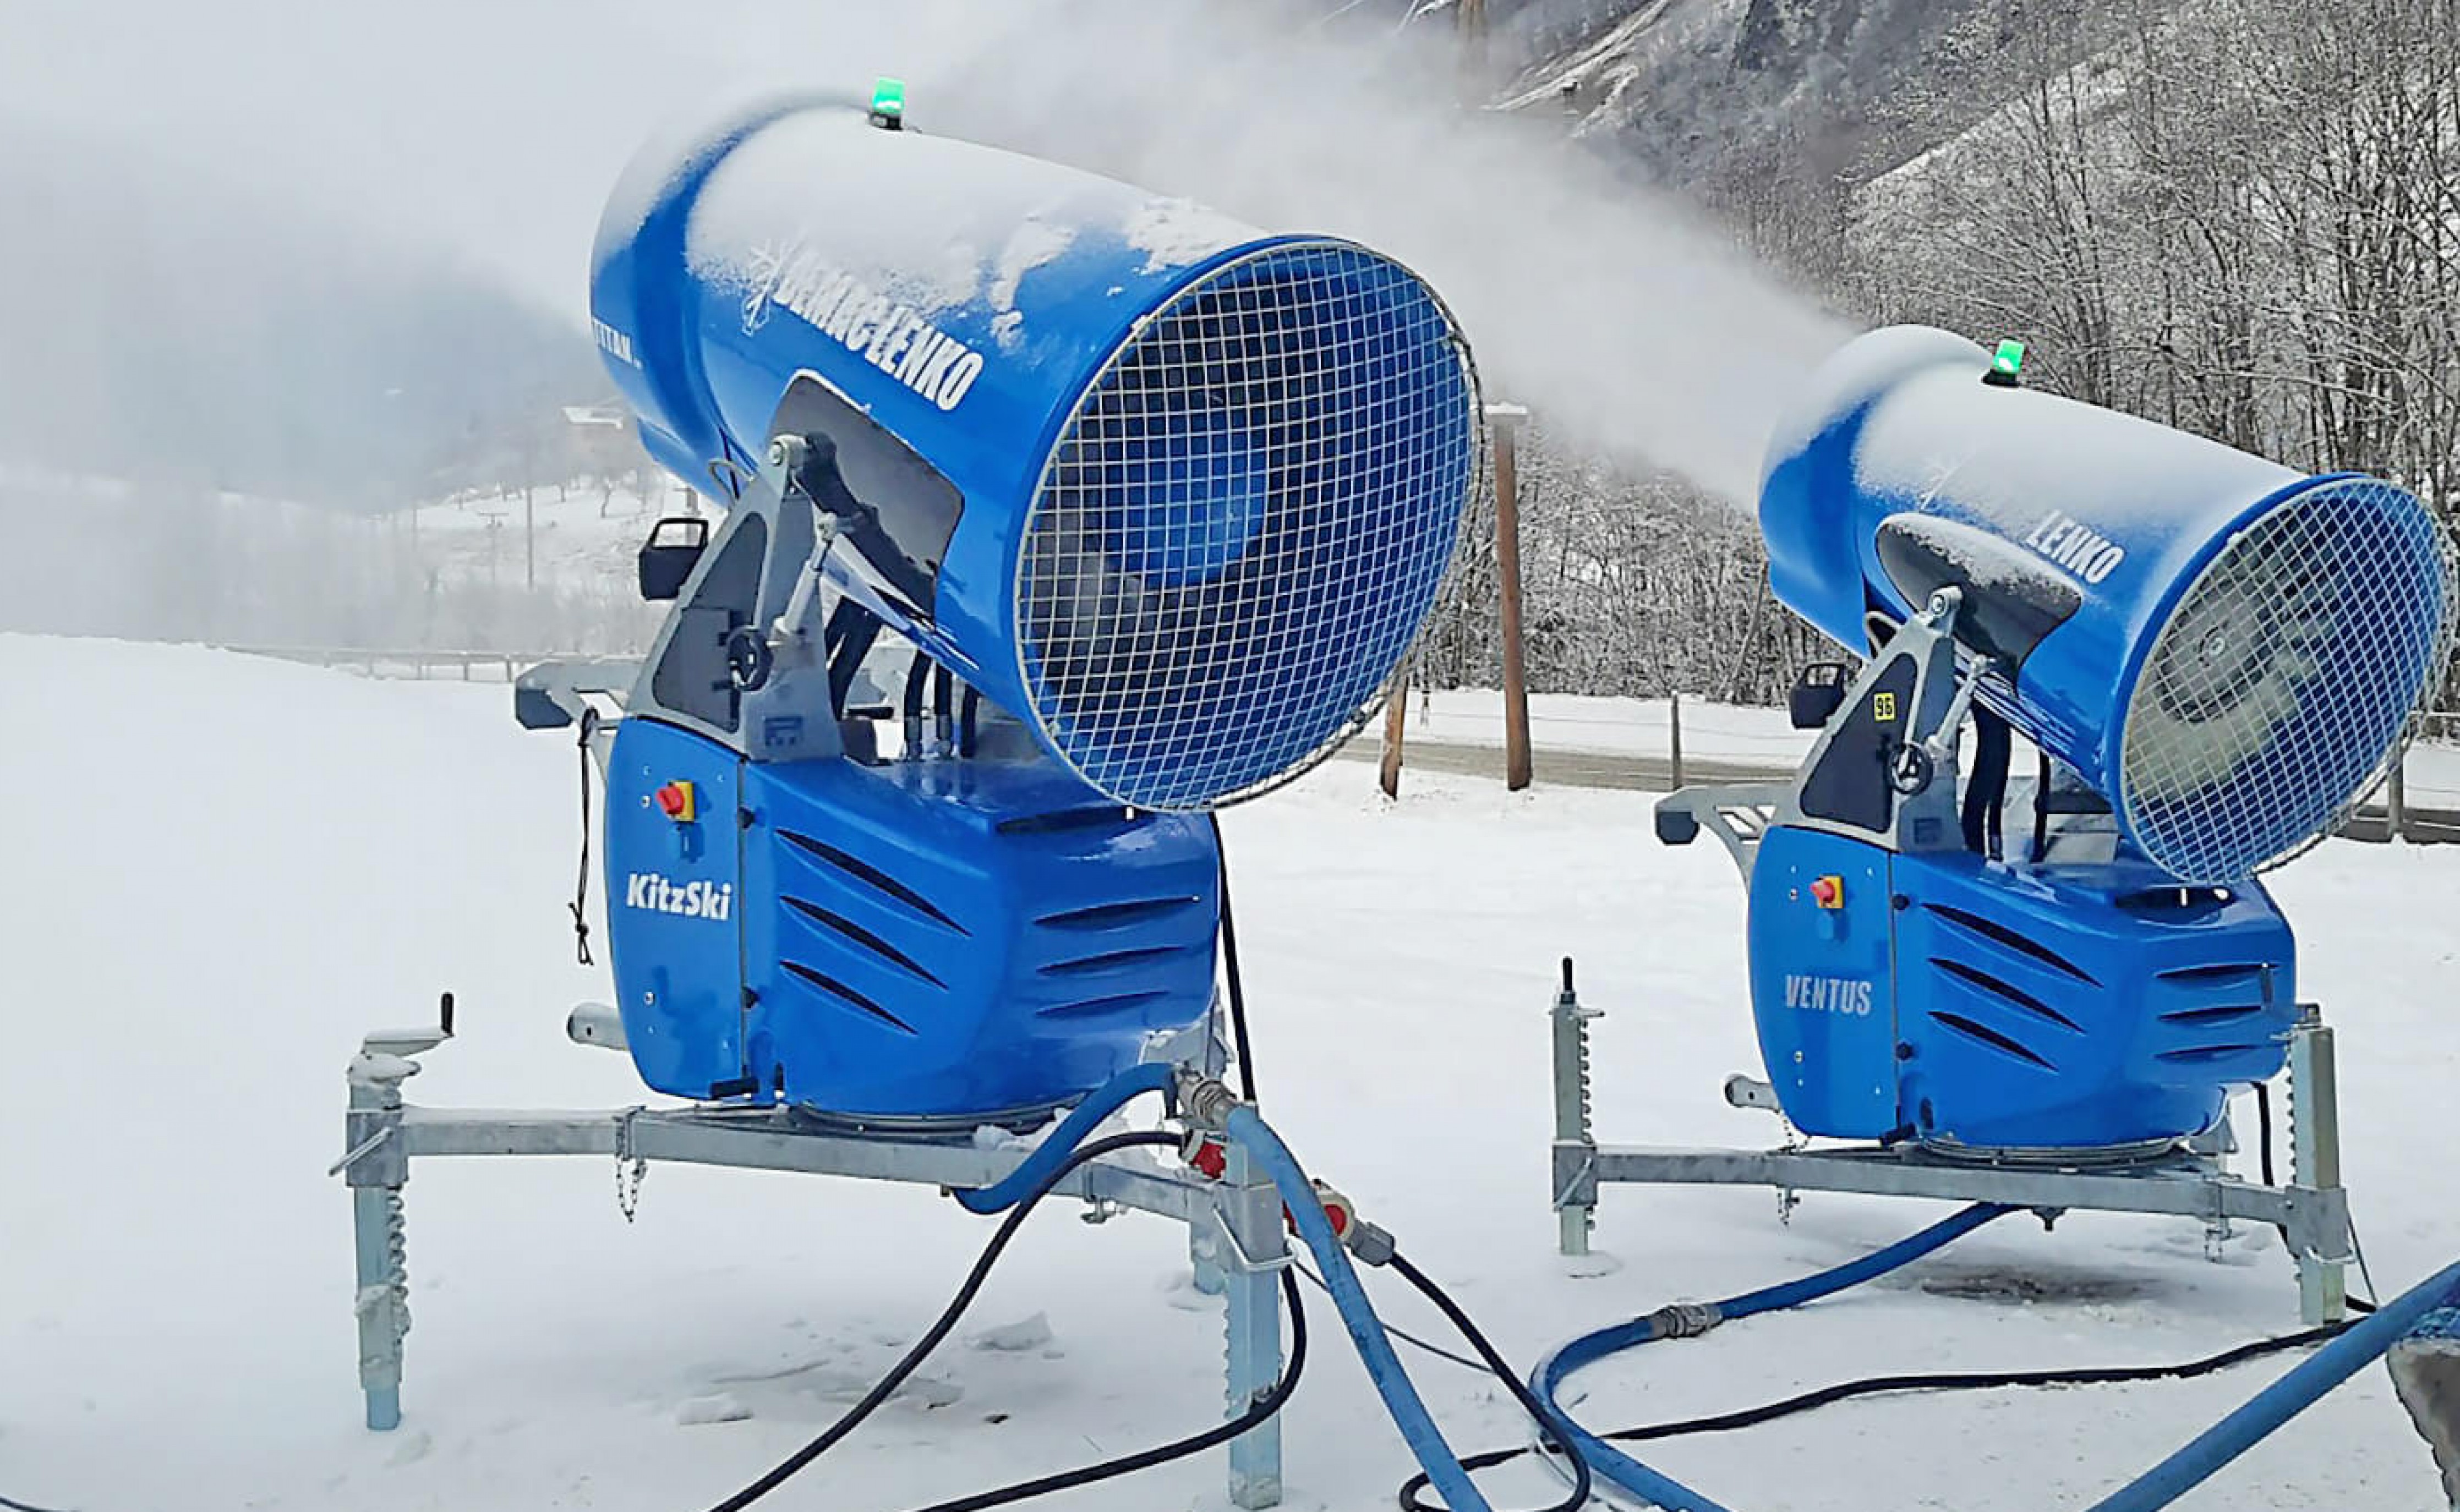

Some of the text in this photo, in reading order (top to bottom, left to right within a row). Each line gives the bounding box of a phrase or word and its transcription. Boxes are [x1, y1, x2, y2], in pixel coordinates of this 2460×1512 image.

[1876, 697, 1893, 716] 96
[626, 873, 732, 922] KitzSki
[1785, 974, 1872, 1016] VENTUS
